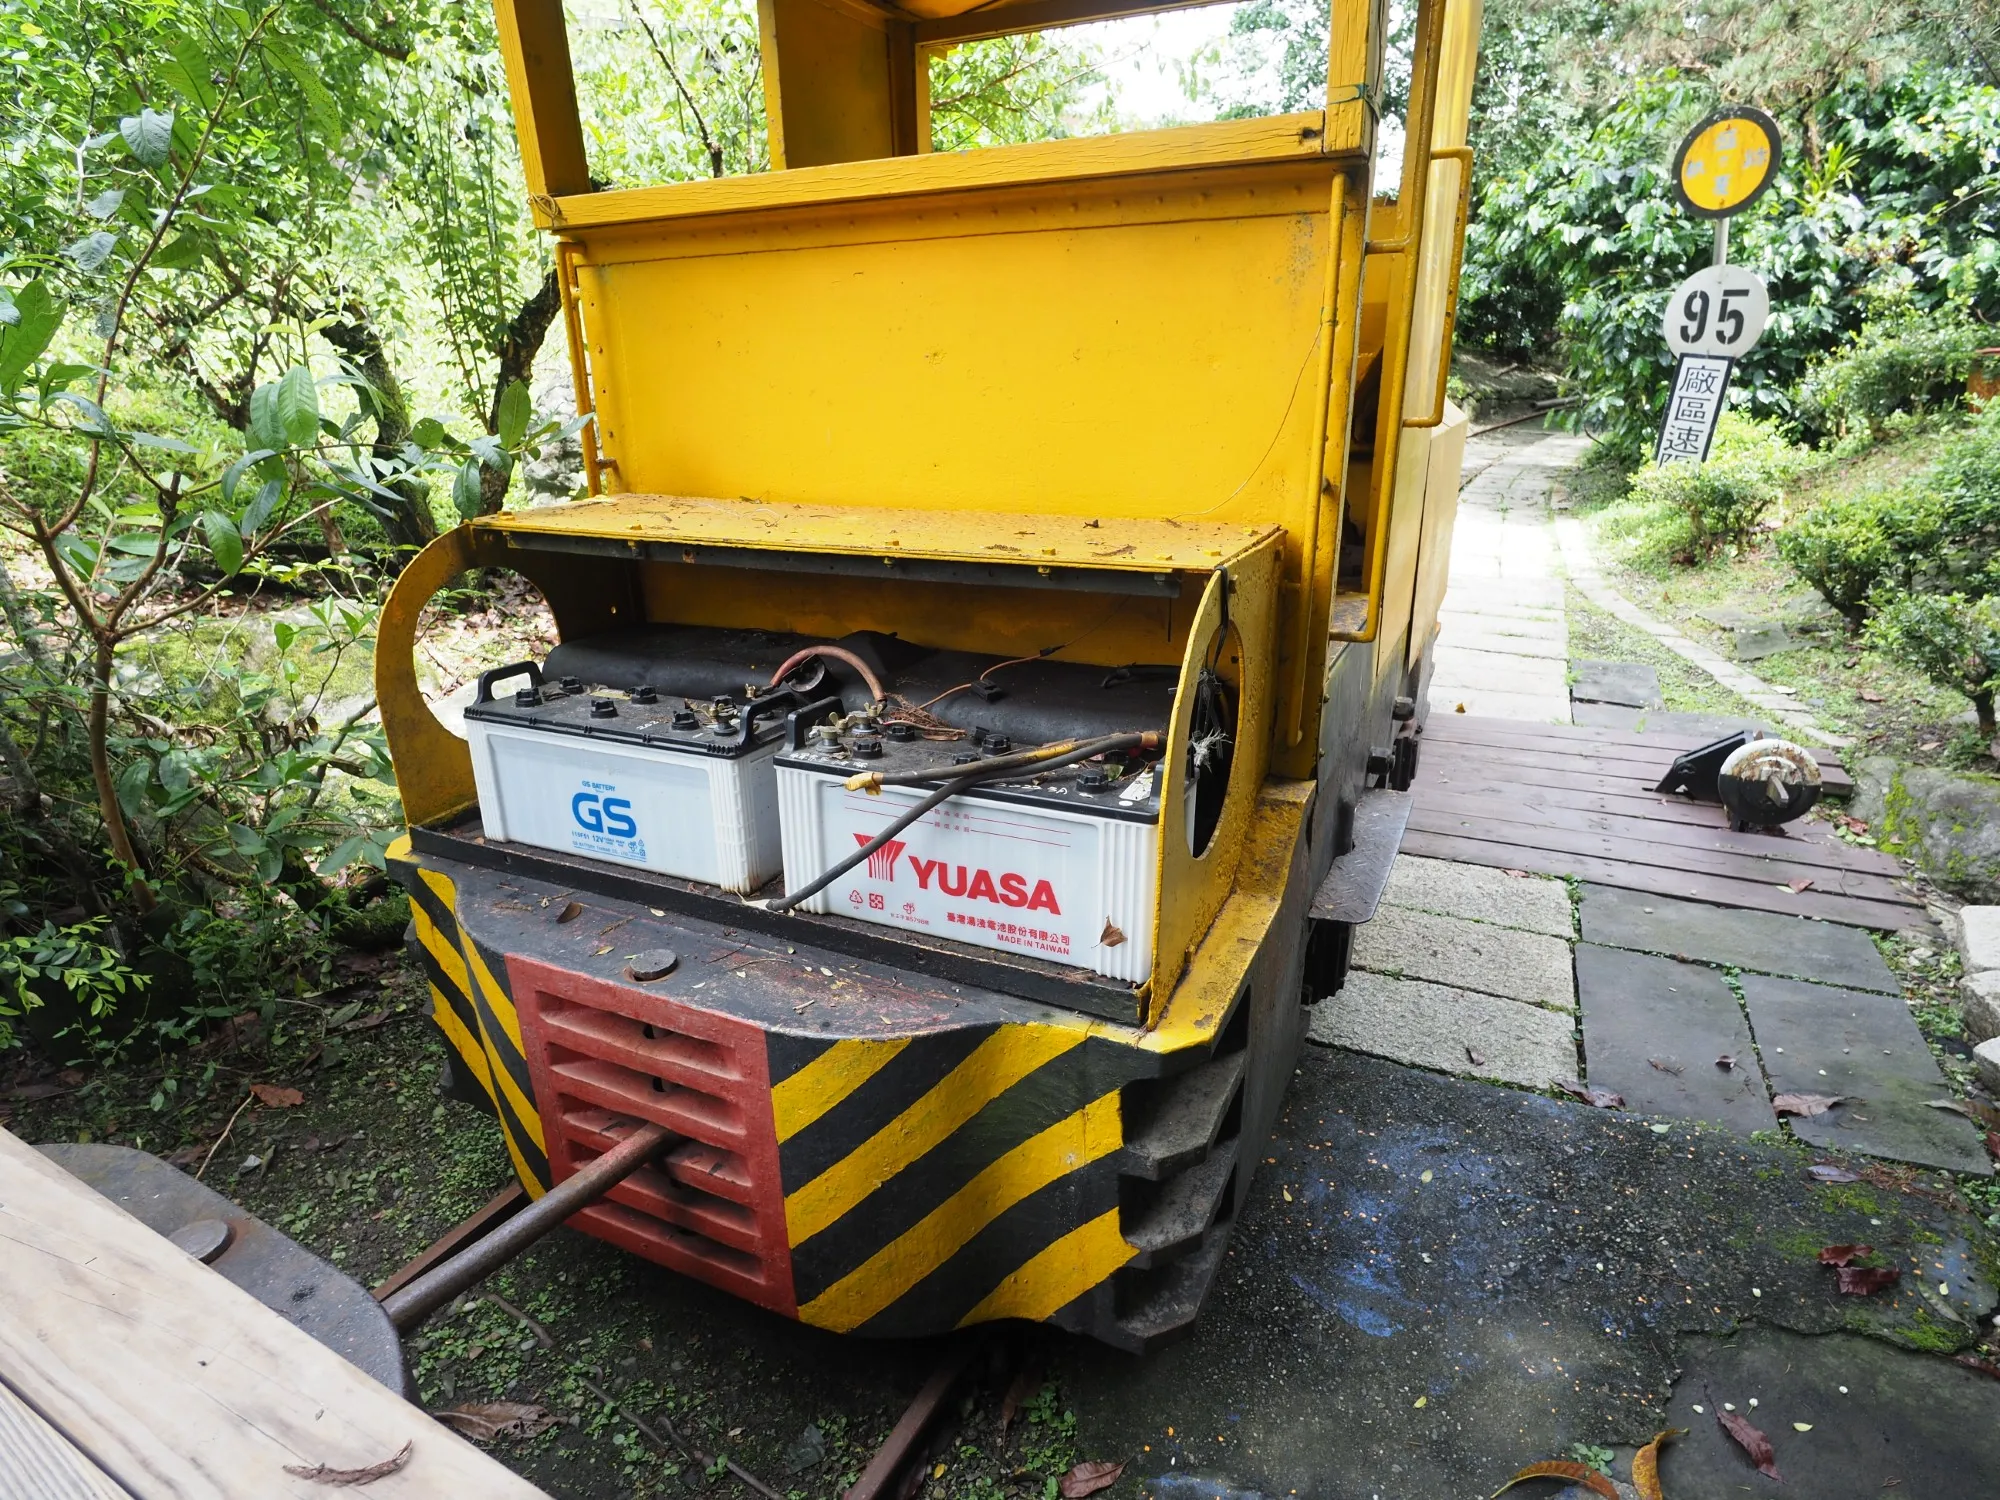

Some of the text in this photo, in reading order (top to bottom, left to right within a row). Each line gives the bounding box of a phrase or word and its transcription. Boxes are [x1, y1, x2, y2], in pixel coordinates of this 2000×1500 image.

[1679, 288, 1750, 345] 95
[591, 782, 616, 792] BATTERY
[571, 792, 637, 839] GS
[908, 855, 1062, 916] YUASA
[997, 933, 1070, 956] MADE IN TAIWAN
